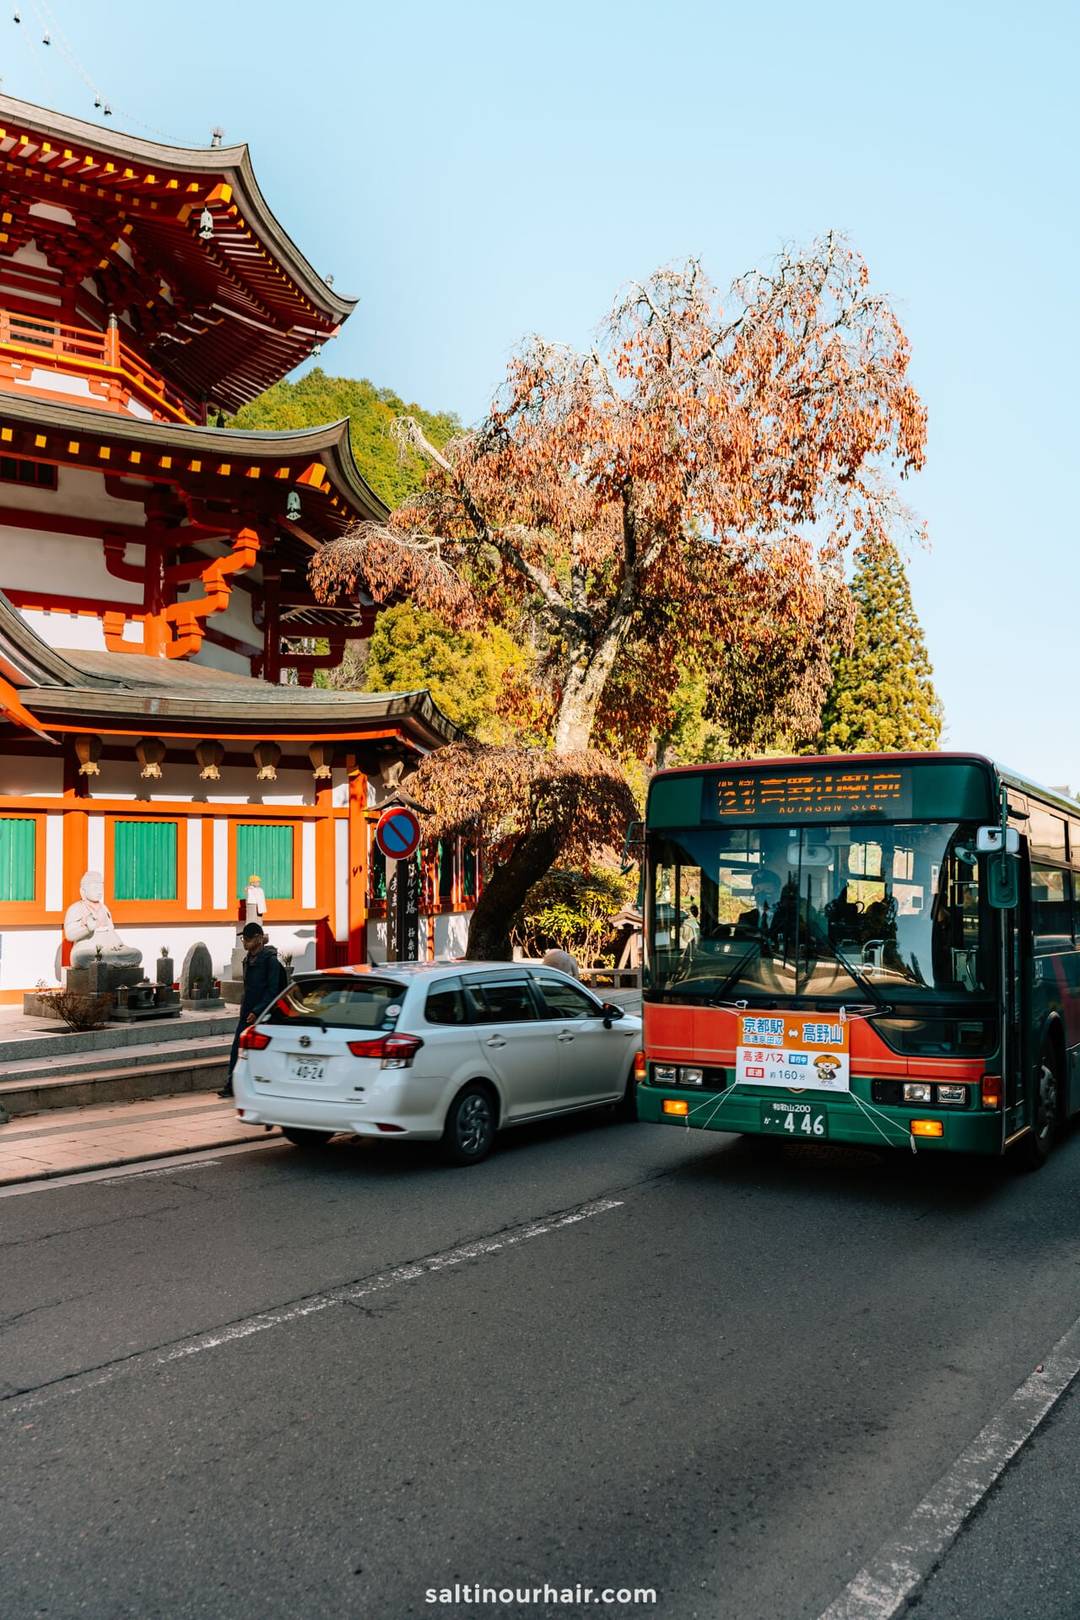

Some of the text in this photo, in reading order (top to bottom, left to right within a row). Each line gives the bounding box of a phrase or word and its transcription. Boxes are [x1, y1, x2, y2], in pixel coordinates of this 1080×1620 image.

[743, 1017, 845, 1044] 京都駅 高野山
[743, 1051, 785, 1064] 高速バス
